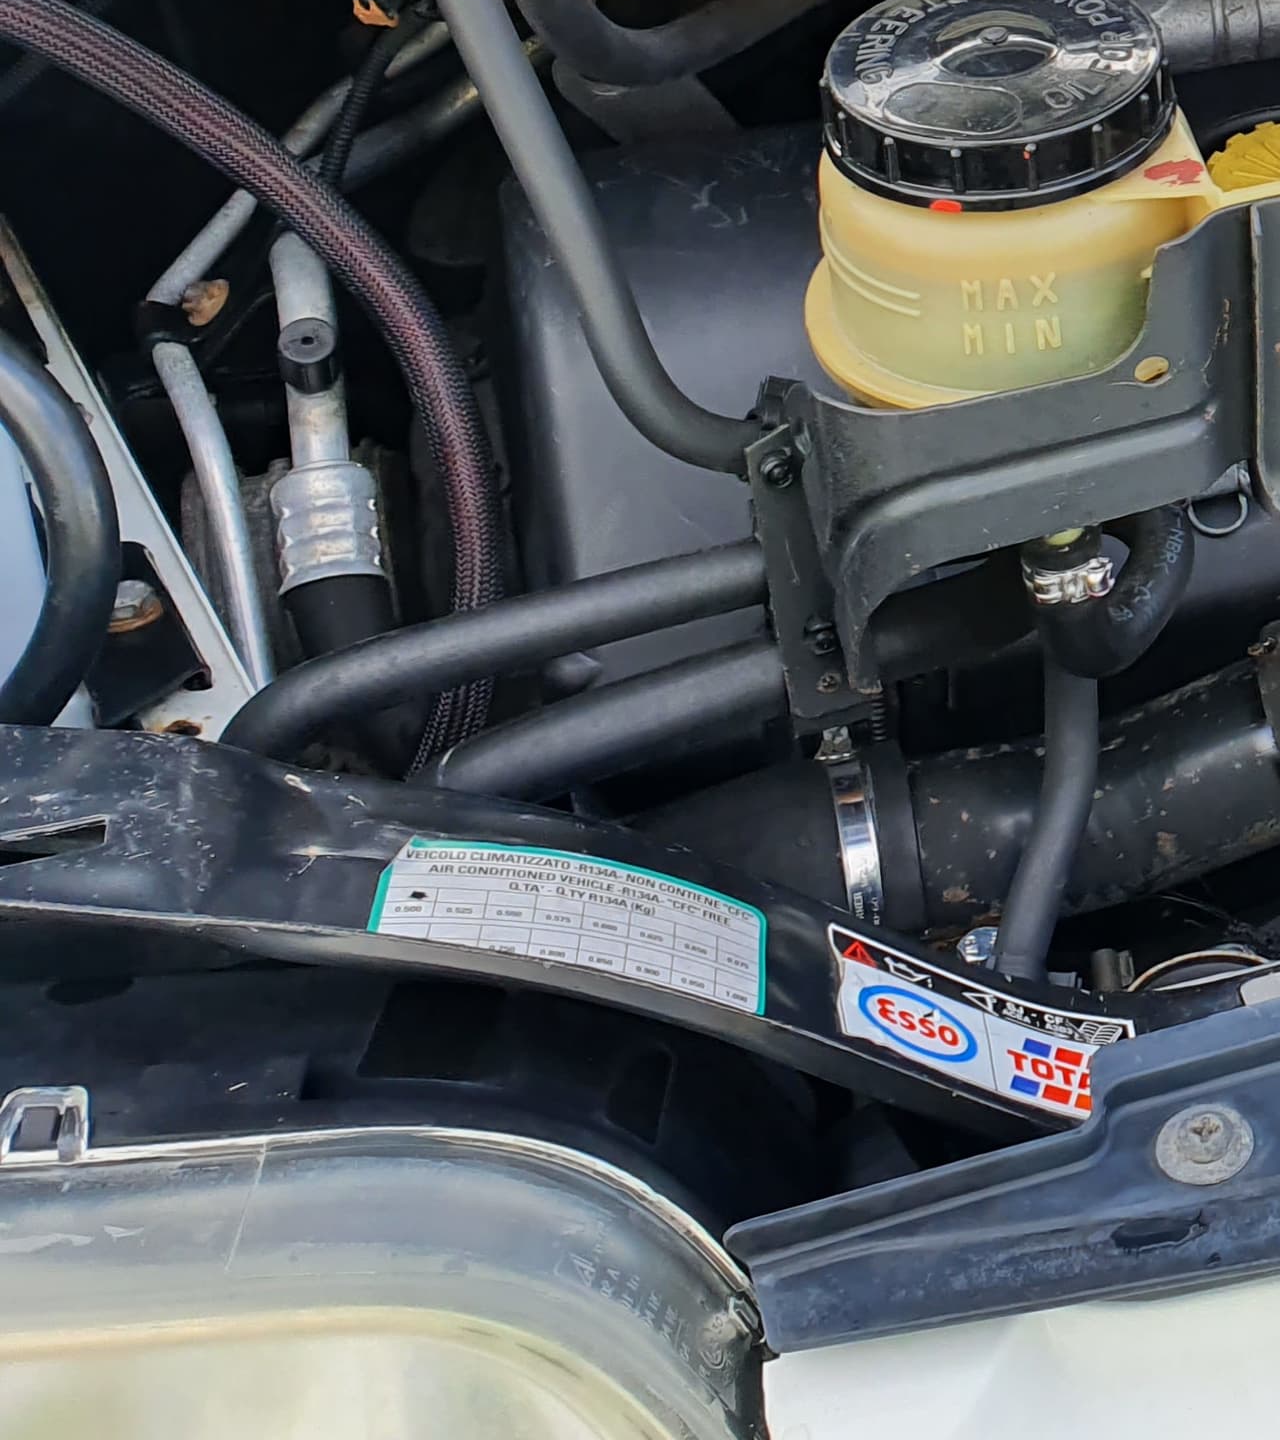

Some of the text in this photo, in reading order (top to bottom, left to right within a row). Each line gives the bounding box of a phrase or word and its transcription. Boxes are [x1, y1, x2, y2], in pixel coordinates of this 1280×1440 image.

[1041, 75, 1106, 110] OIL
[960, 271, 1059, 311] MAX
[962, 316, 1063, 355] MIN
[406, 849, 467, 861] VEICOLO
[470, 851, 571, 870] CLIMATIZZATO
[626, 873, 656, 889] NON
[658, 881, 721, 909] CONTIENE
[429, 863, 454, 874] AIR
[457, 864, 556, 881] CONDITIONED
[560, 874, 615, 895] VEHICLE
[702, 910, 731, 927] FREE
[588, 892, 627, 908] R134A
[630, 901, 656, 917] (Kg)
